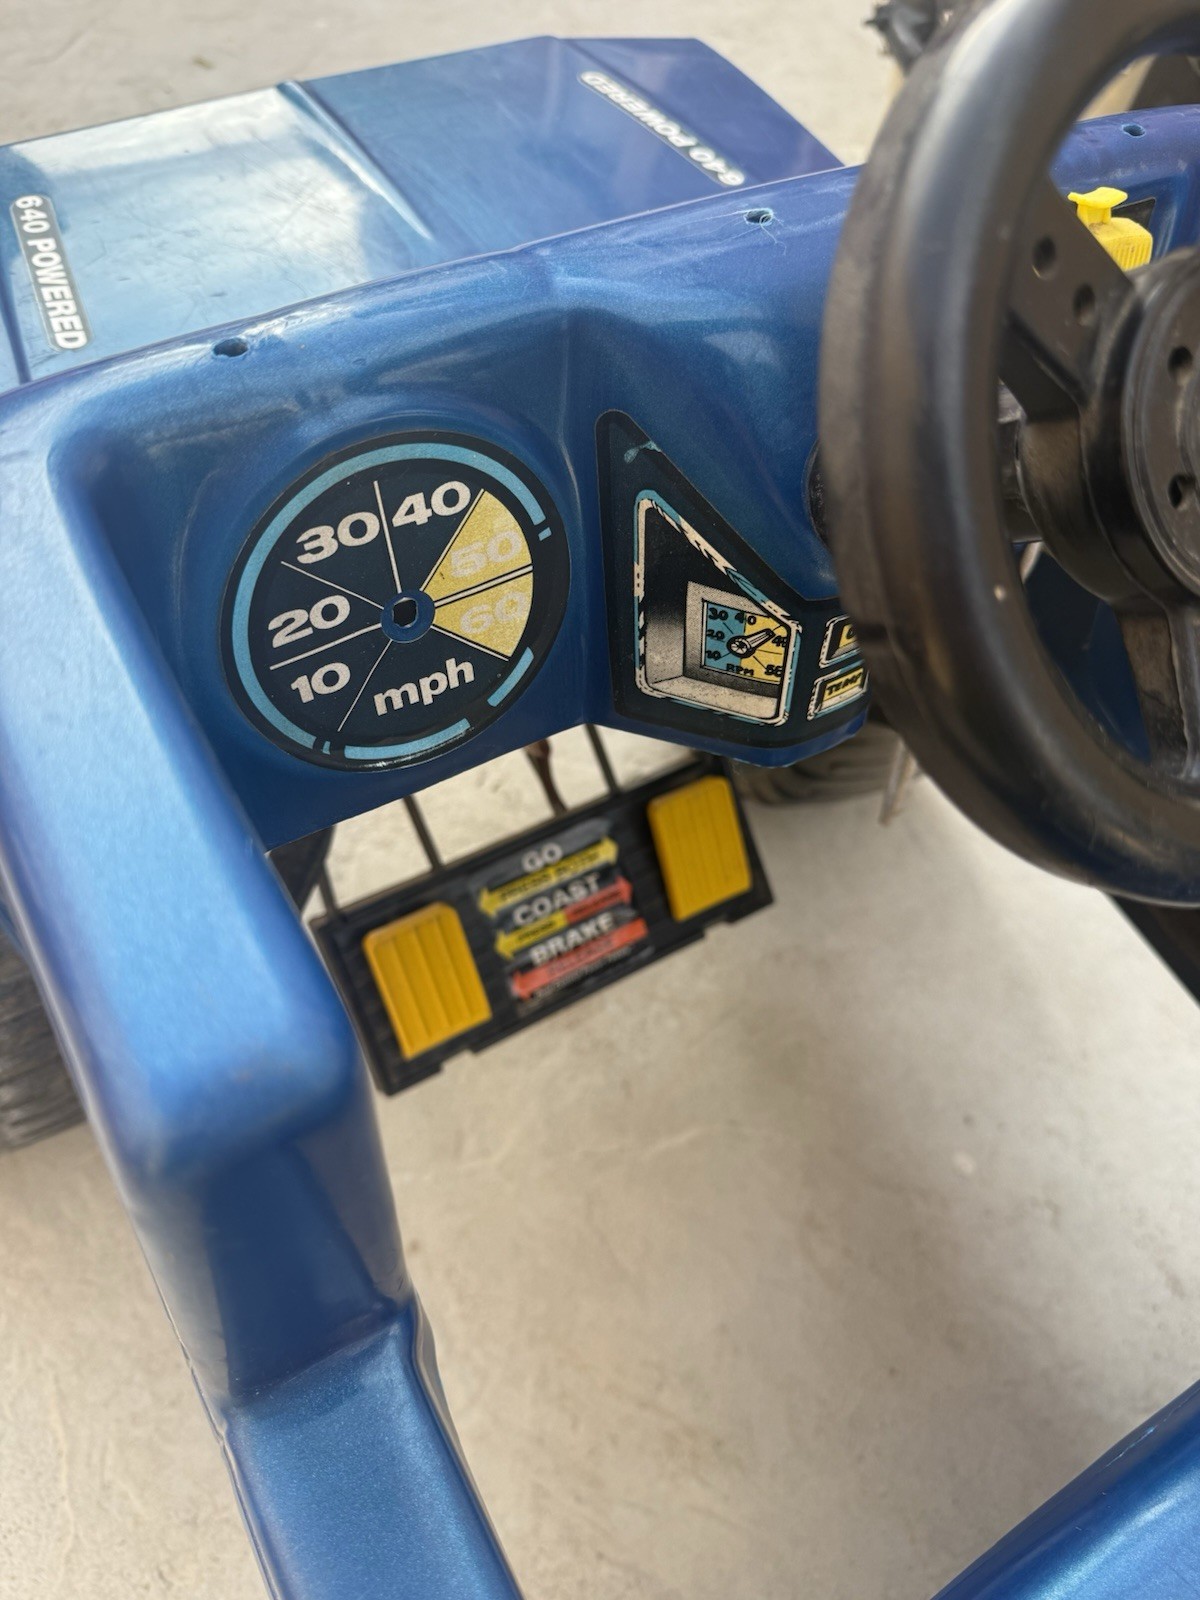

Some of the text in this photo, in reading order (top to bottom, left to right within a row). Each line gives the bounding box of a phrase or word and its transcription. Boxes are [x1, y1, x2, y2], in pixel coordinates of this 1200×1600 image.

[689, 146, 745, 186] 640
[15, 195, 88, 349] 640 POWERED
[392, 480, 471, 527] 40
[296, 511, 380, 564] 30
[450, 530, 522, 578] 50
[268, 595, 350, 648] 20
[459, 591, 529, 635] 60
[706, 628, 725, 641] 20
[708, 607, 729, 620] 30
[735, 612, 757, 625] 40
[705, 650, 721, 661] 10
[726, 663, 754, 677] RPM
[290, 662, 350, 704] 10
[373, 657, 475, 716] mph
[521, 842, 563, 873] GO
[512, 872, 600, 926] COAST
[530, 912, 614, 966] BRAKE
